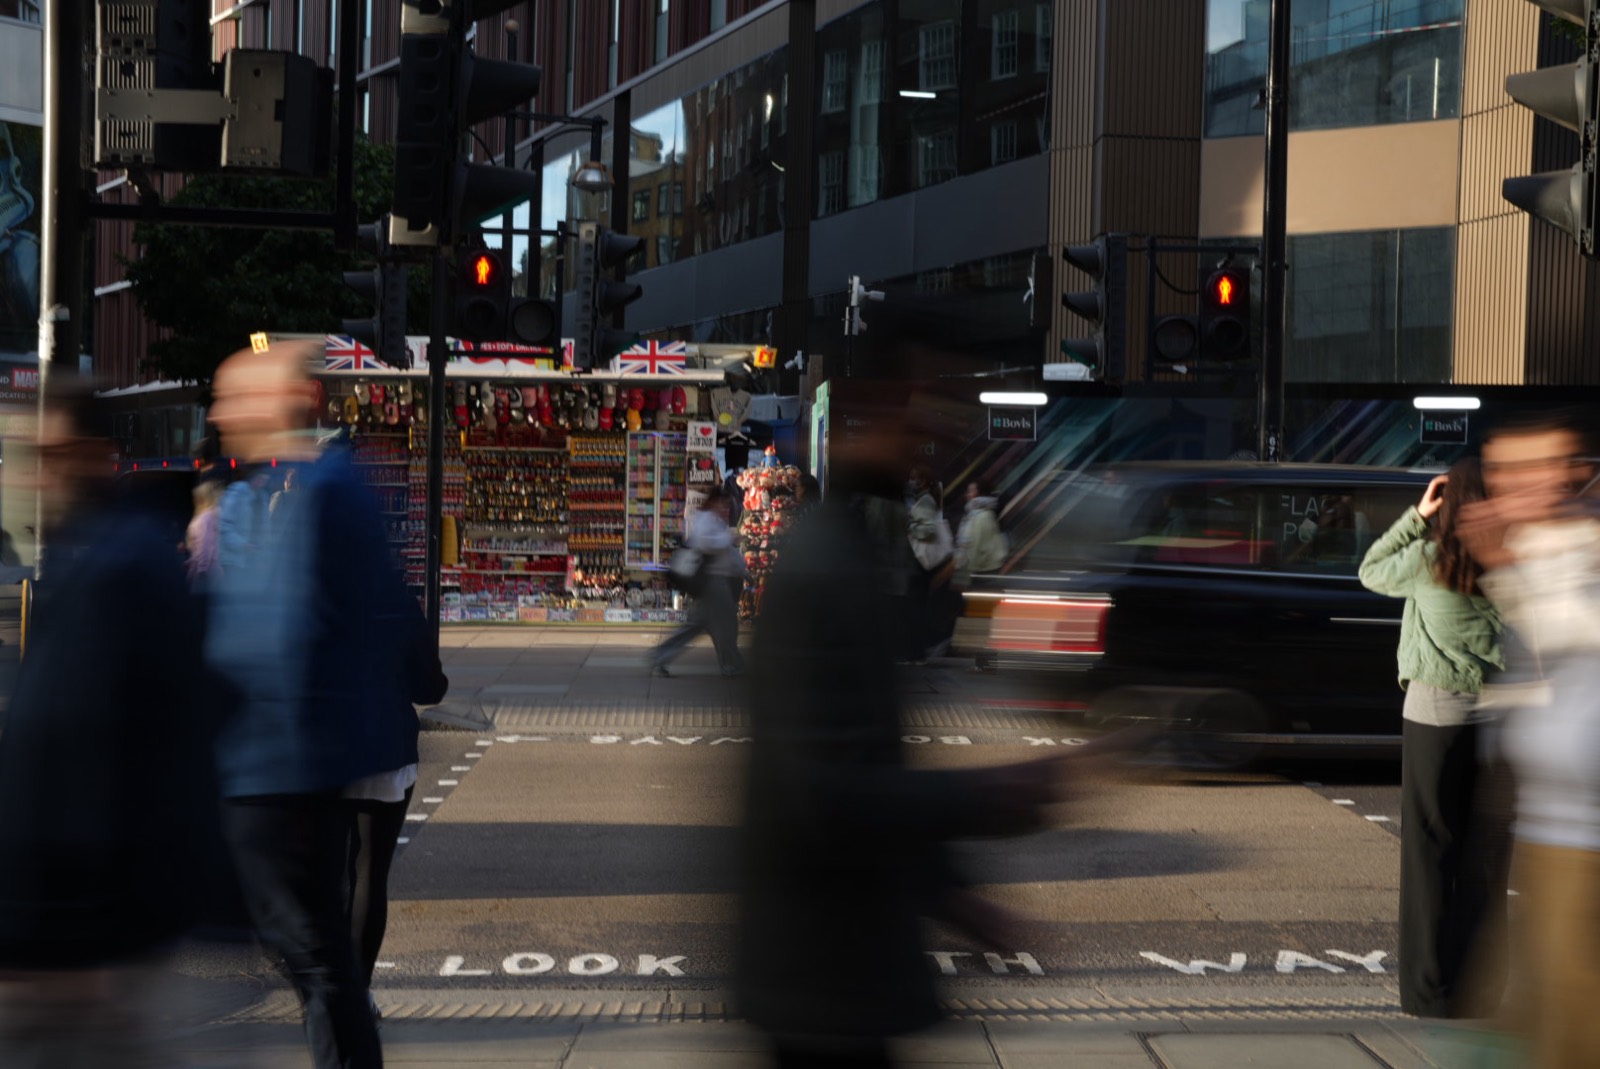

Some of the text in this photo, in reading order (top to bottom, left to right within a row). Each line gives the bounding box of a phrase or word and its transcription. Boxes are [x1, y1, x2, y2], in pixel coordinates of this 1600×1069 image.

[1002, 416, 1031, 429] Bovis
[1434, 420, 1463, 432] Bovis
[689, 435, 714, 447] LONDON
[689, 470, 714, 483] LONDON
[439, 951, 687, 978] LOOK
[922, 950, 1046, 977] TH
